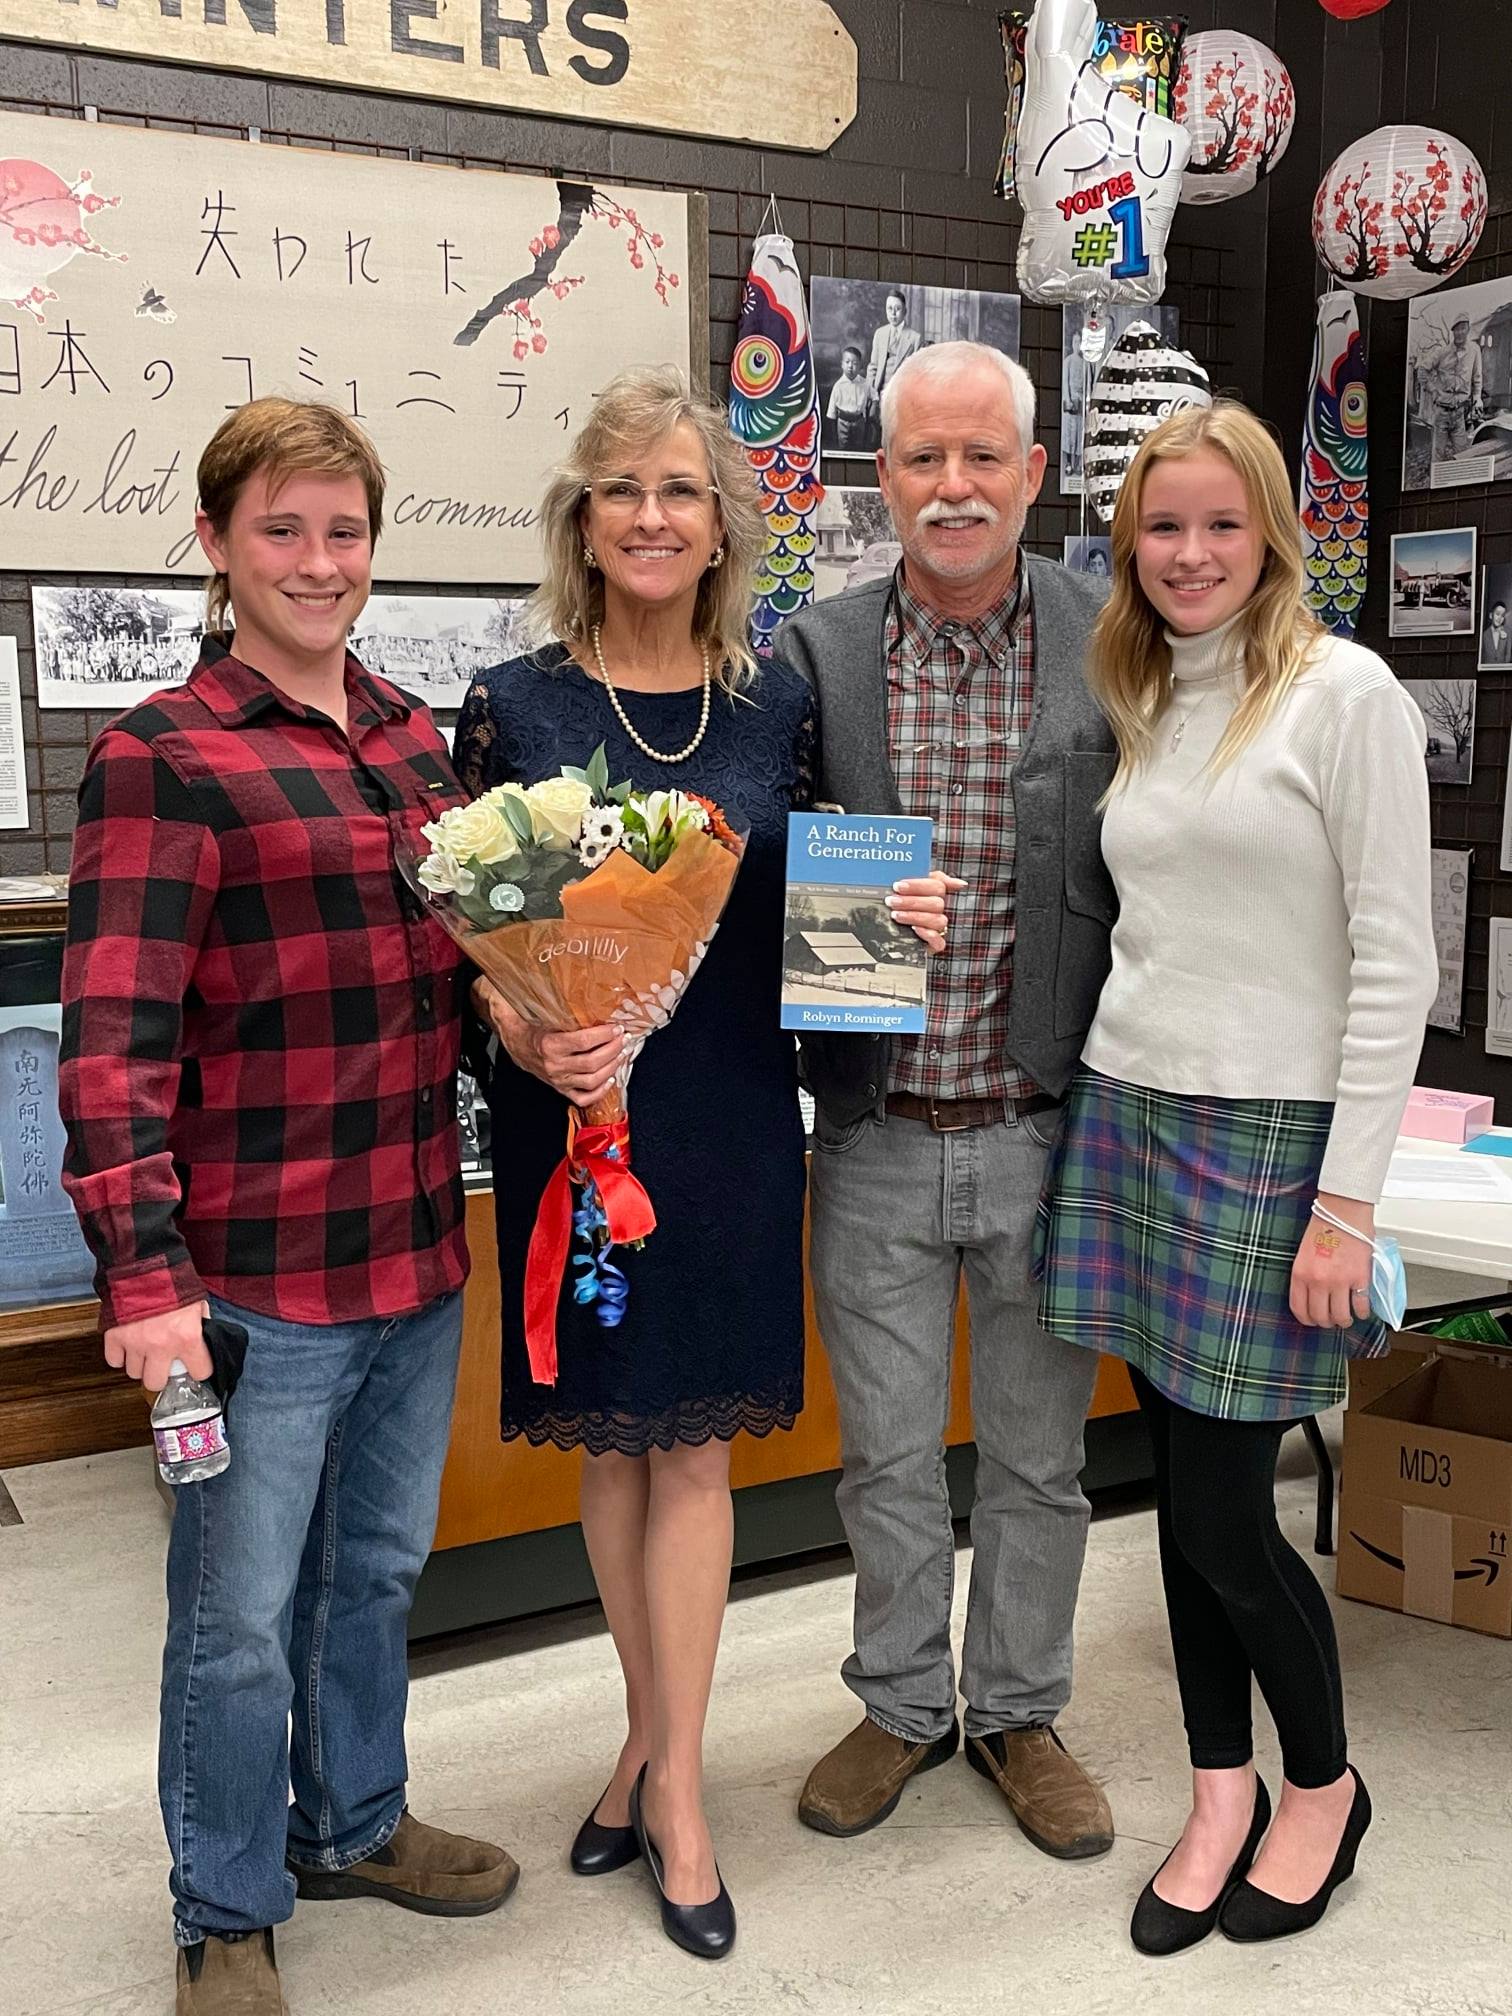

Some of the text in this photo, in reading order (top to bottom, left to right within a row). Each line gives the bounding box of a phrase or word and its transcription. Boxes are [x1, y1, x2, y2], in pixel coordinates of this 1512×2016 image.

[1056, 171, 1136, 221] YOU'RE
[195, 189, 467, 295] 失われた
[1072, 196, 1150, 280] #1
[83, 428, 181, 515] lost
[393, 493, 541, 528] commu
[807, 824, 916, 845] A Ranch For
[807, 842, 913, 862] Generations
[803, 1010, 903, 1027] Robyn Rominger
[1400, 1446, 1452, 1488] MD3
